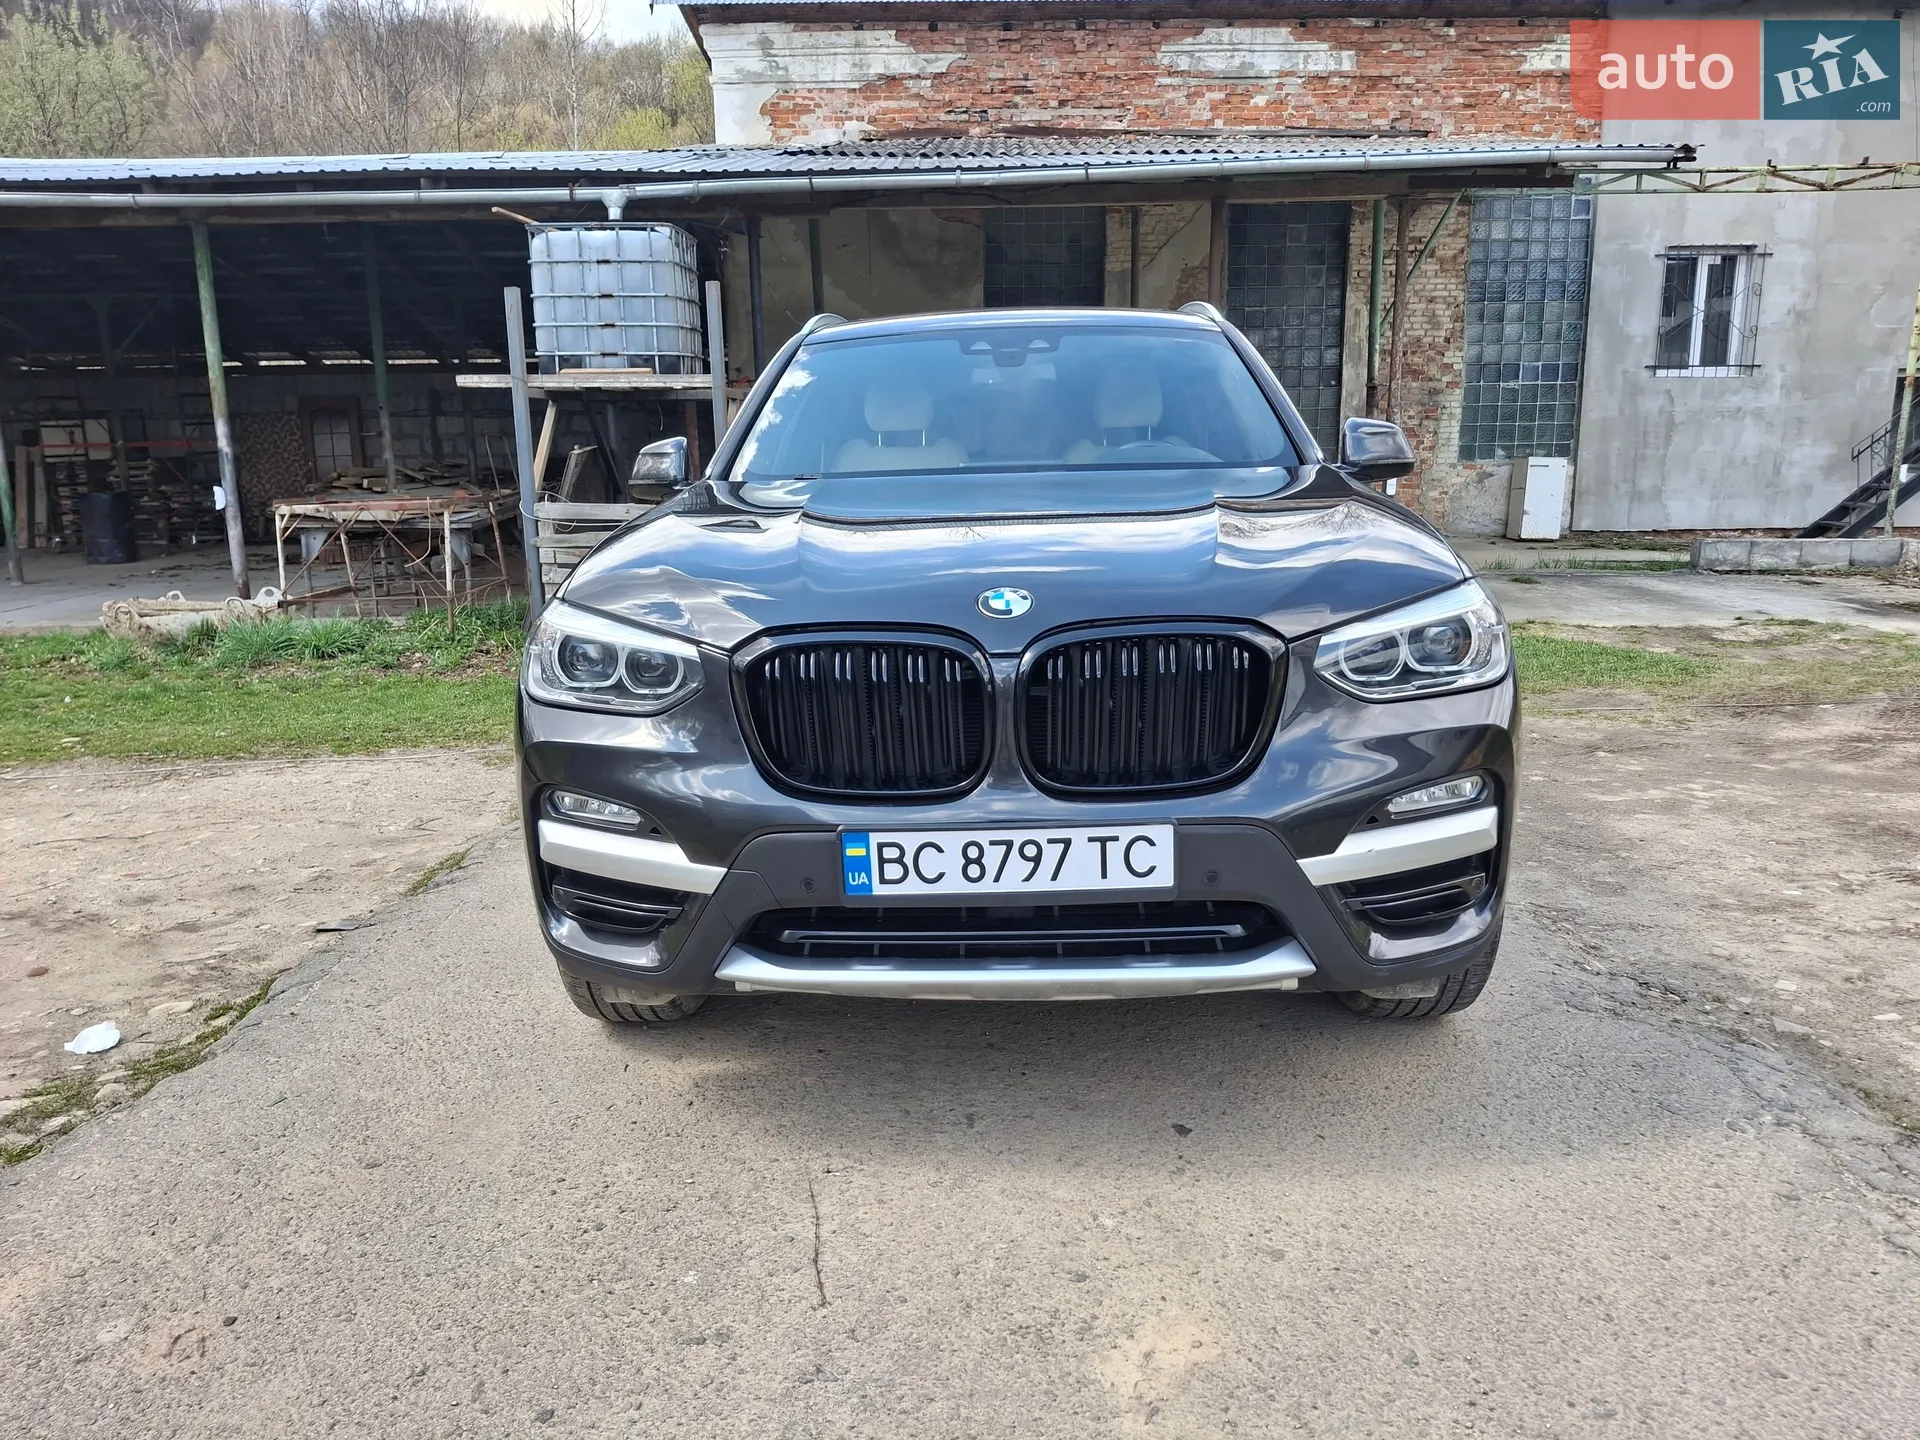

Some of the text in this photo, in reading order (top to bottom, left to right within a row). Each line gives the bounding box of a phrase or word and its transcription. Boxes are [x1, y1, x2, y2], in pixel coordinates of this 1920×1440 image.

[875, 834, 1158, 885] BC 8797 TC
[848, 872, 869, 886] UA
